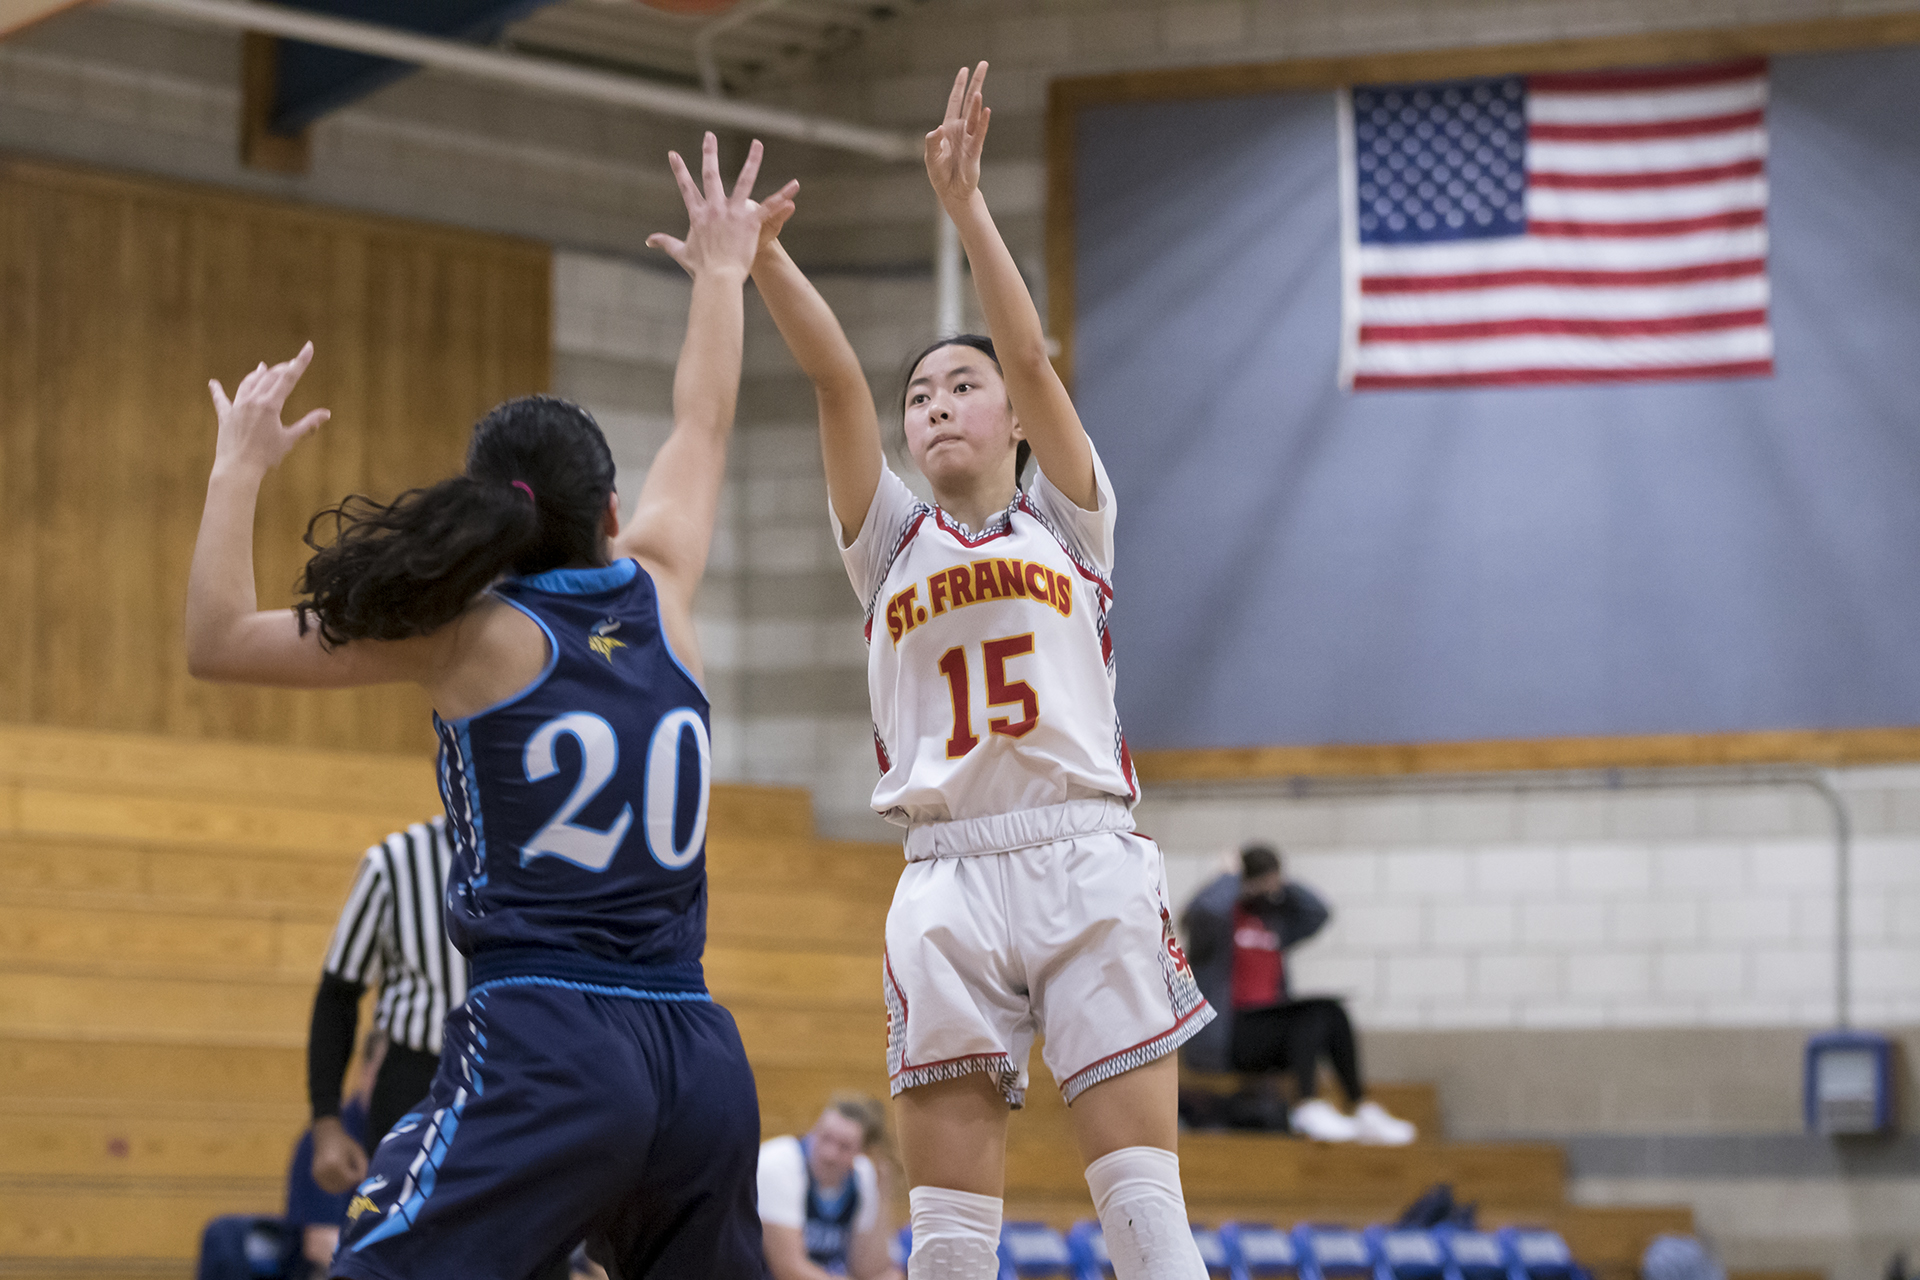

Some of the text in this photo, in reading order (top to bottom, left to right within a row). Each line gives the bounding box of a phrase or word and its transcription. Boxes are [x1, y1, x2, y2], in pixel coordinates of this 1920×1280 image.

[886, 558, 1073, 650] ST. FRANCIS
[938, 631, 1040, 760] 15
[519, 706, 712, 873] 20
